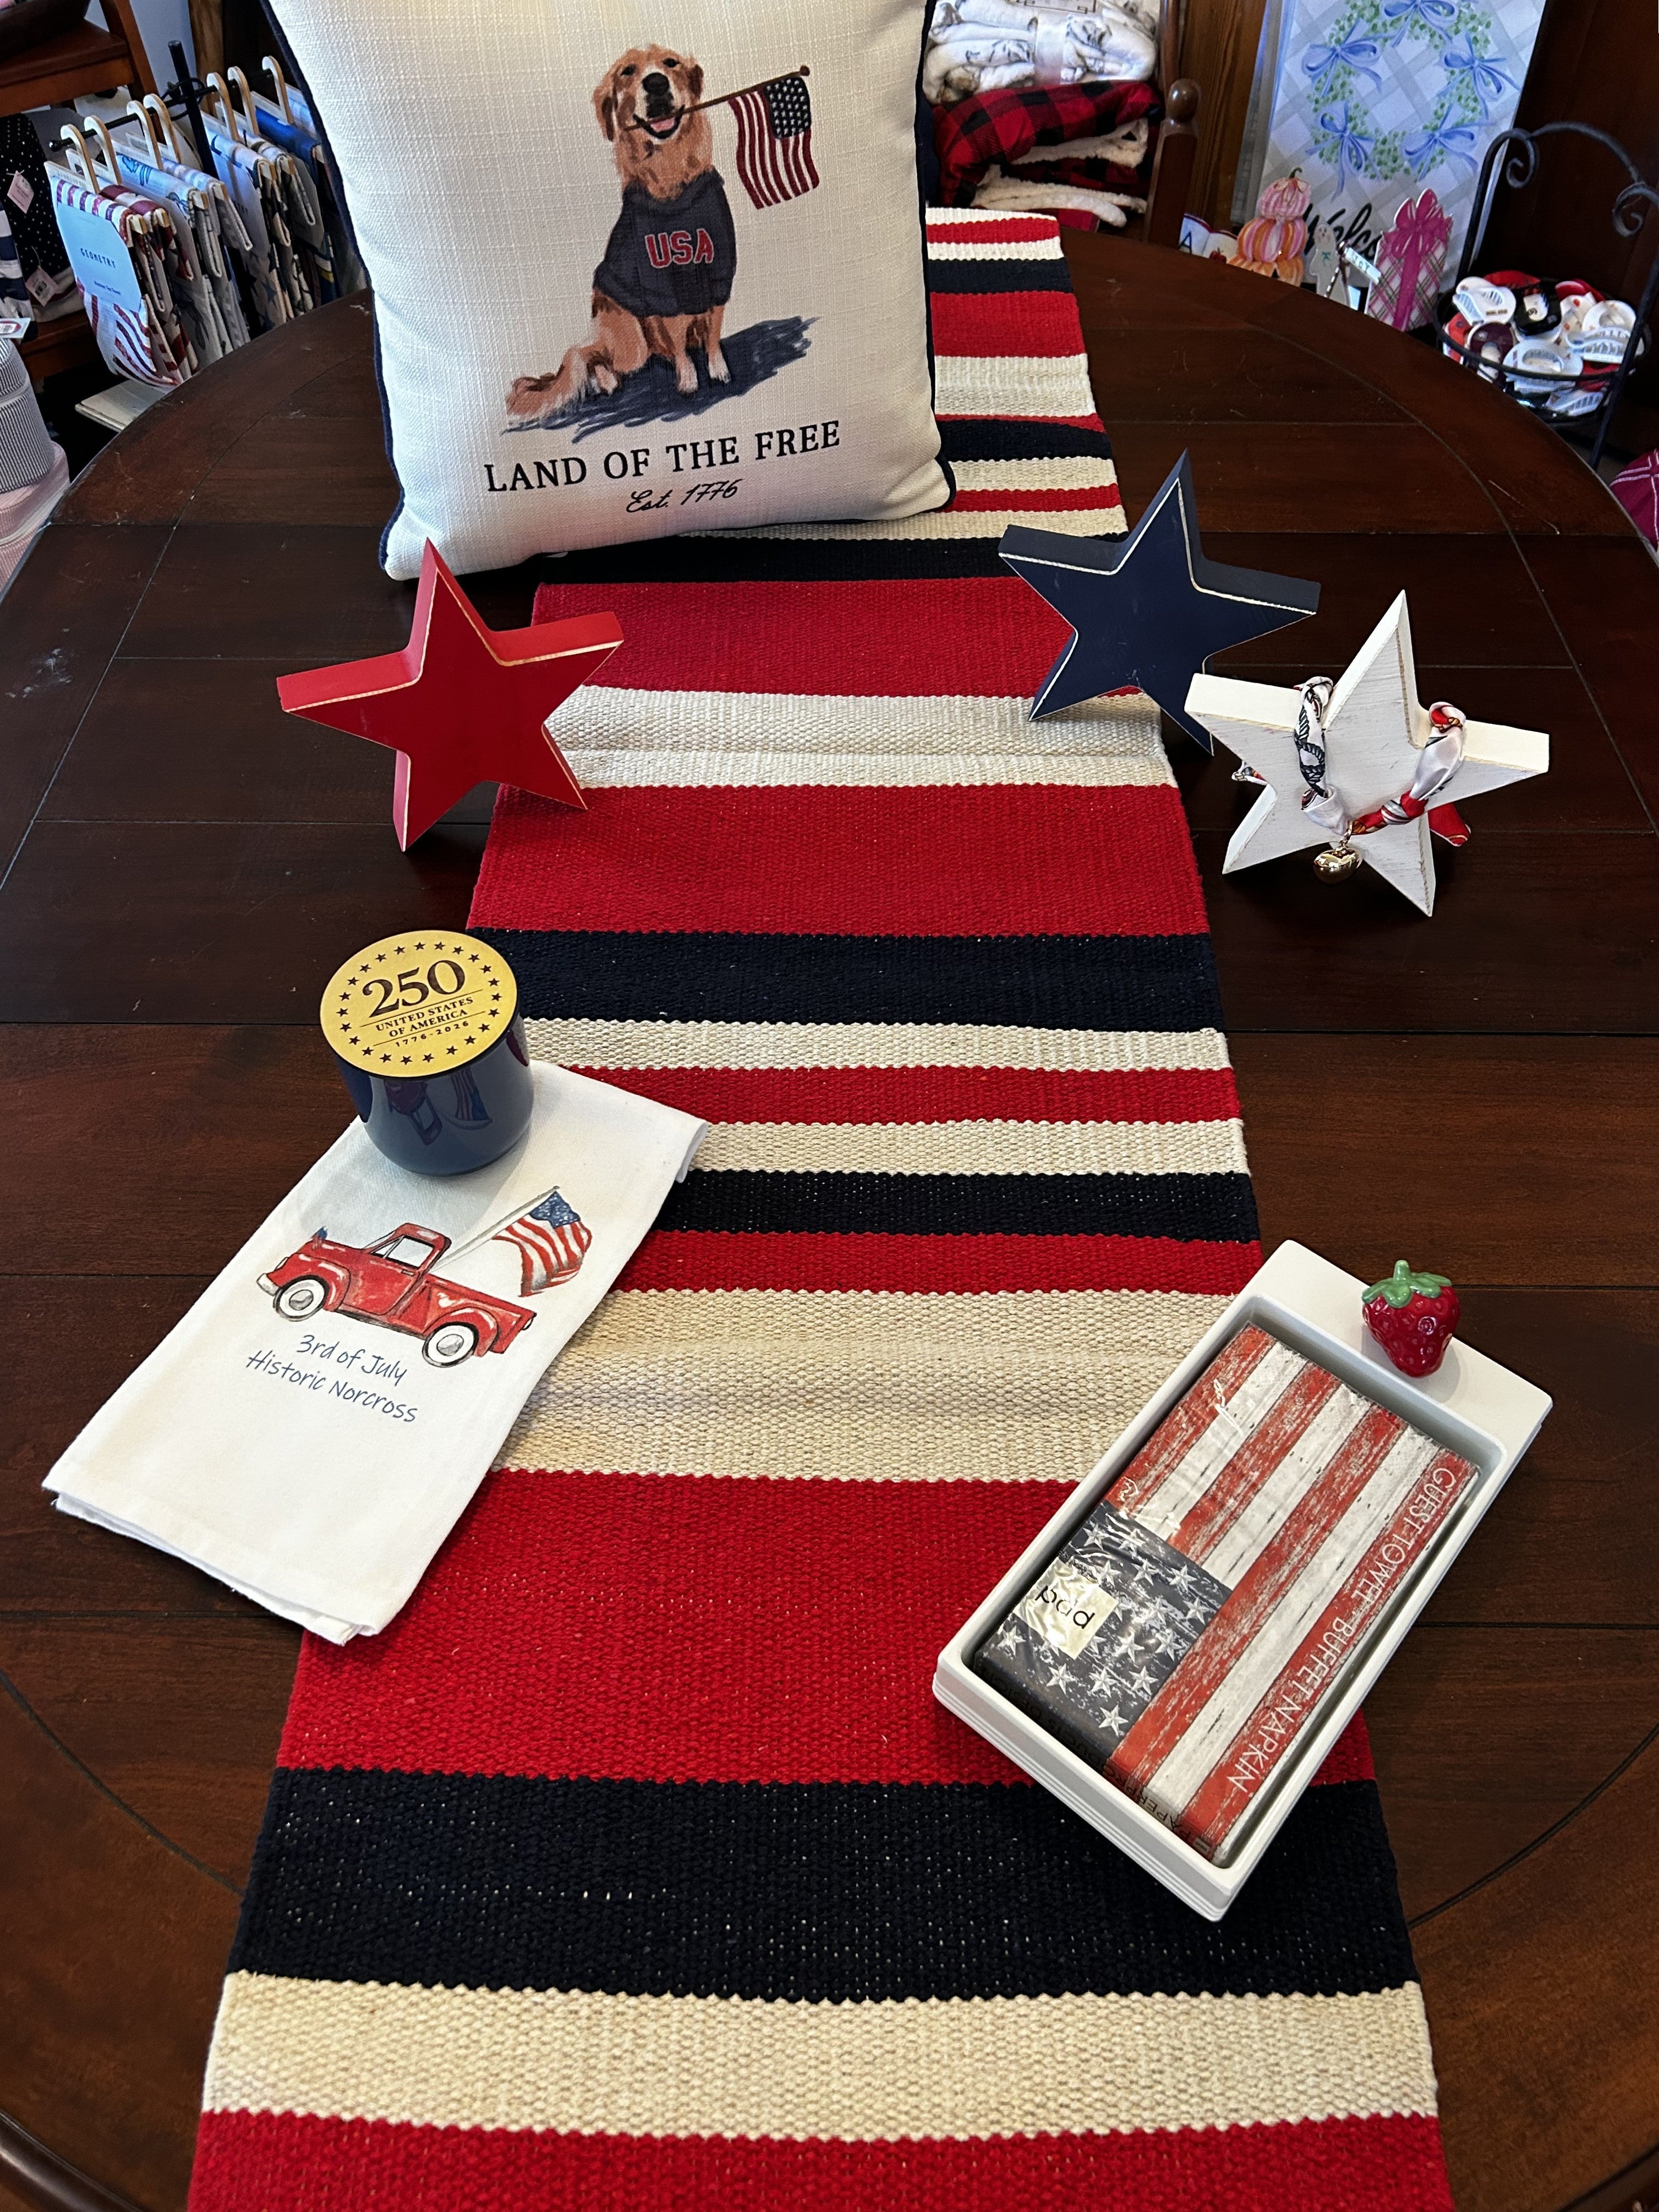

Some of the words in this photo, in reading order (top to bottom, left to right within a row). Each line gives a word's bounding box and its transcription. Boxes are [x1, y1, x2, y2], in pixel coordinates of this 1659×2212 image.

[80, 248, 116, 269] GEOMETRY
[645, 228, 714, 268] USA
[1351, 253, 1370, 273] JOY
[484, 458, 587, 492] LAND
[604, 448, 650, 480] OF
[666, 437, 740, 473] THE
[754, 420, 840, 461] FREE
[626, 489, 672, 513] Est.
[681, 479, 743, 506] 1776
[362, 960, 466, 1018] 250
[376, 1011, 425, 1032] UNITED
[428, 997, 474, 1016] STATES
[389, 1028, 406, 1038] OF
[410, 1009, 468, 1032] AMERICA
[396, 1021, 469, 1047] 1776-2026
[246, 1350, 326, 1390] Historic
[328, 1380, 418, 1422] Norcross
[297, 1334, 340, 1359] 3rd
[337, 1349, 366, 1369] of
[361, 1355, 408, 1386] July
[1404, 1468, 1457, 1535] GUEST
[1351, 1533, 1406, 1602] TOWEL
[1292, 1617, 1356, 1700] BUFFET
[1227, 1694, 1302, 1793] NAPKIN
